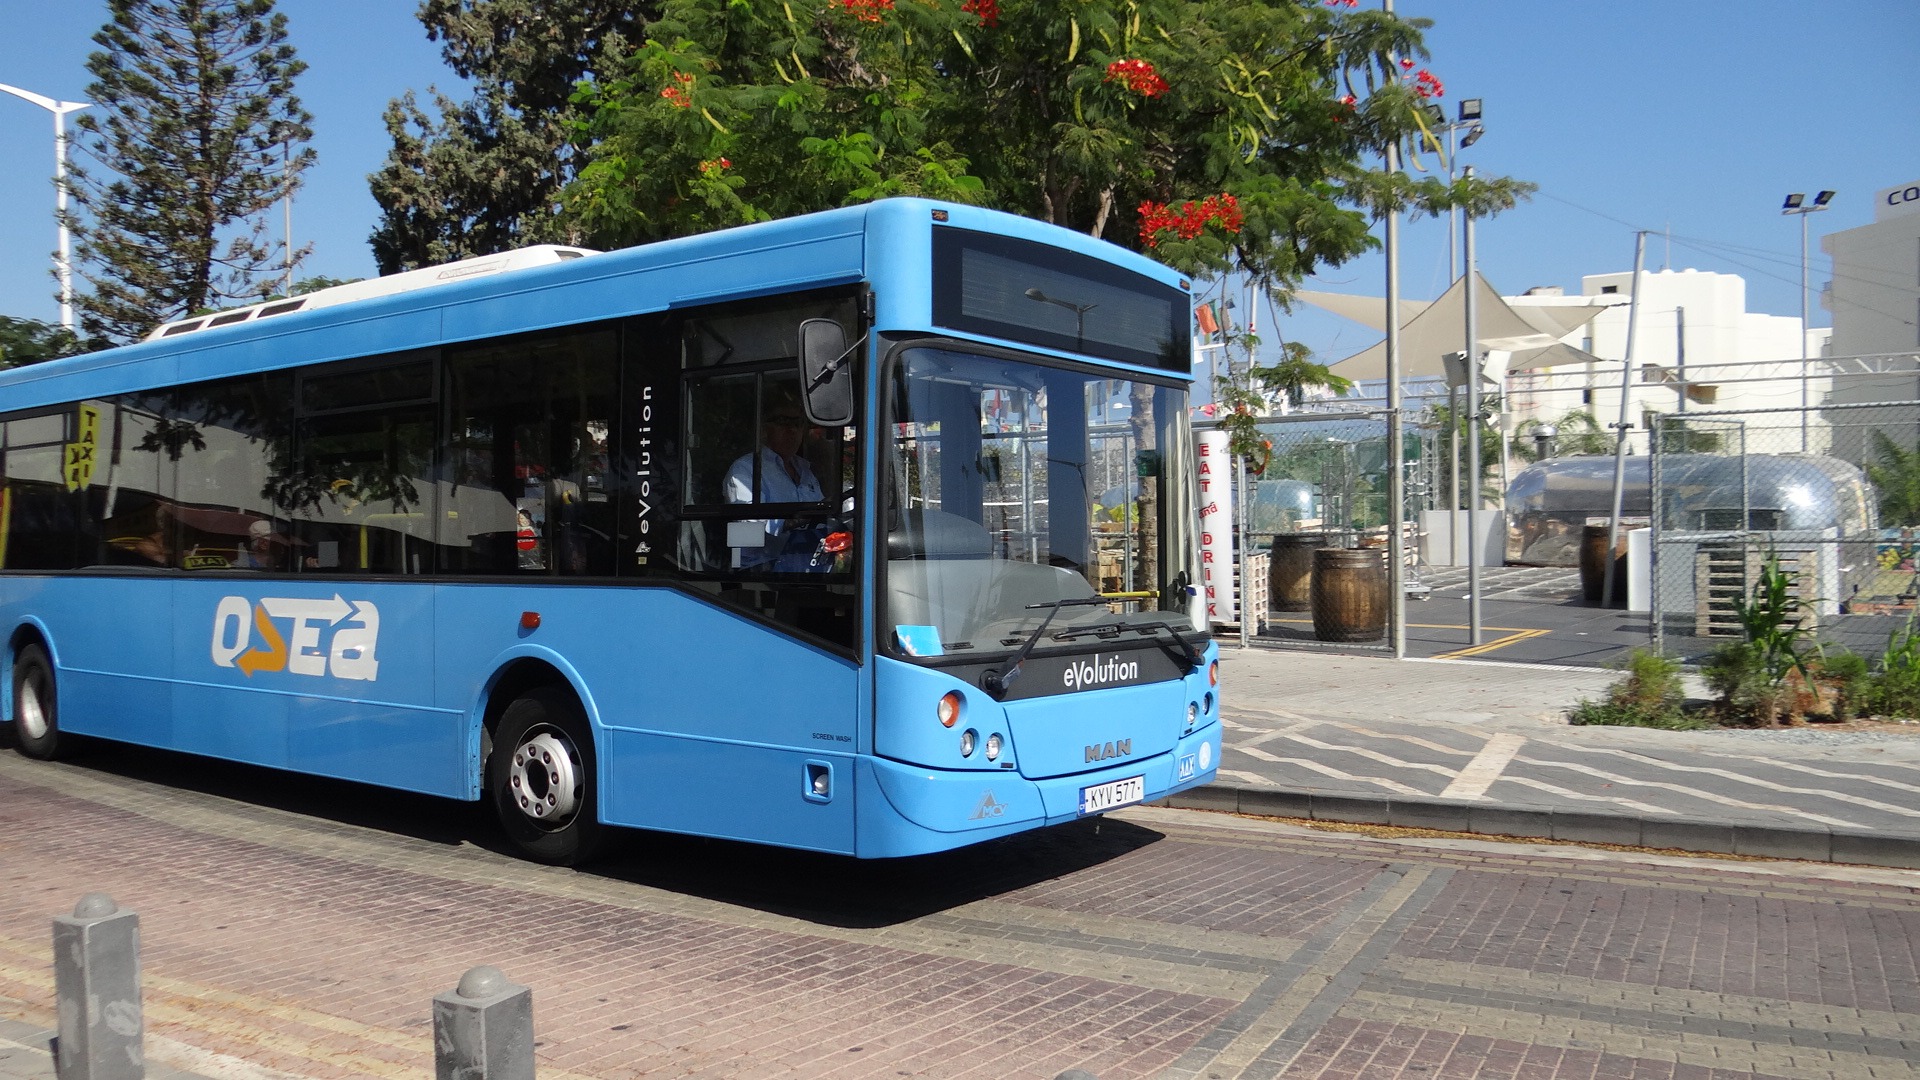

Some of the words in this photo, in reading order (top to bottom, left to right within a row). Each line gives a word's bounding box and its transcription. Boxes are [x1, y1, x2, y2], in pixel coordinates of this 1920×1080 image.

[81, 410, 96, 478] TAXI
[637, 386, 652, 534] eVolution
[1198, 443, 1211, 493] EAT
[1198, 501, 1218, 519] and
[1202, 531, 1218, 617] DRINK
[1063, 653, 1138, 691] eVolution
[812, 732, 834, 741] SCREEN
[835, 735, 852, 743] WASH
[1084, 738, 1132, 763] MAN
[1091, 786, 1112, 808] KYV
[1116, 781, 1136, 803] 577
